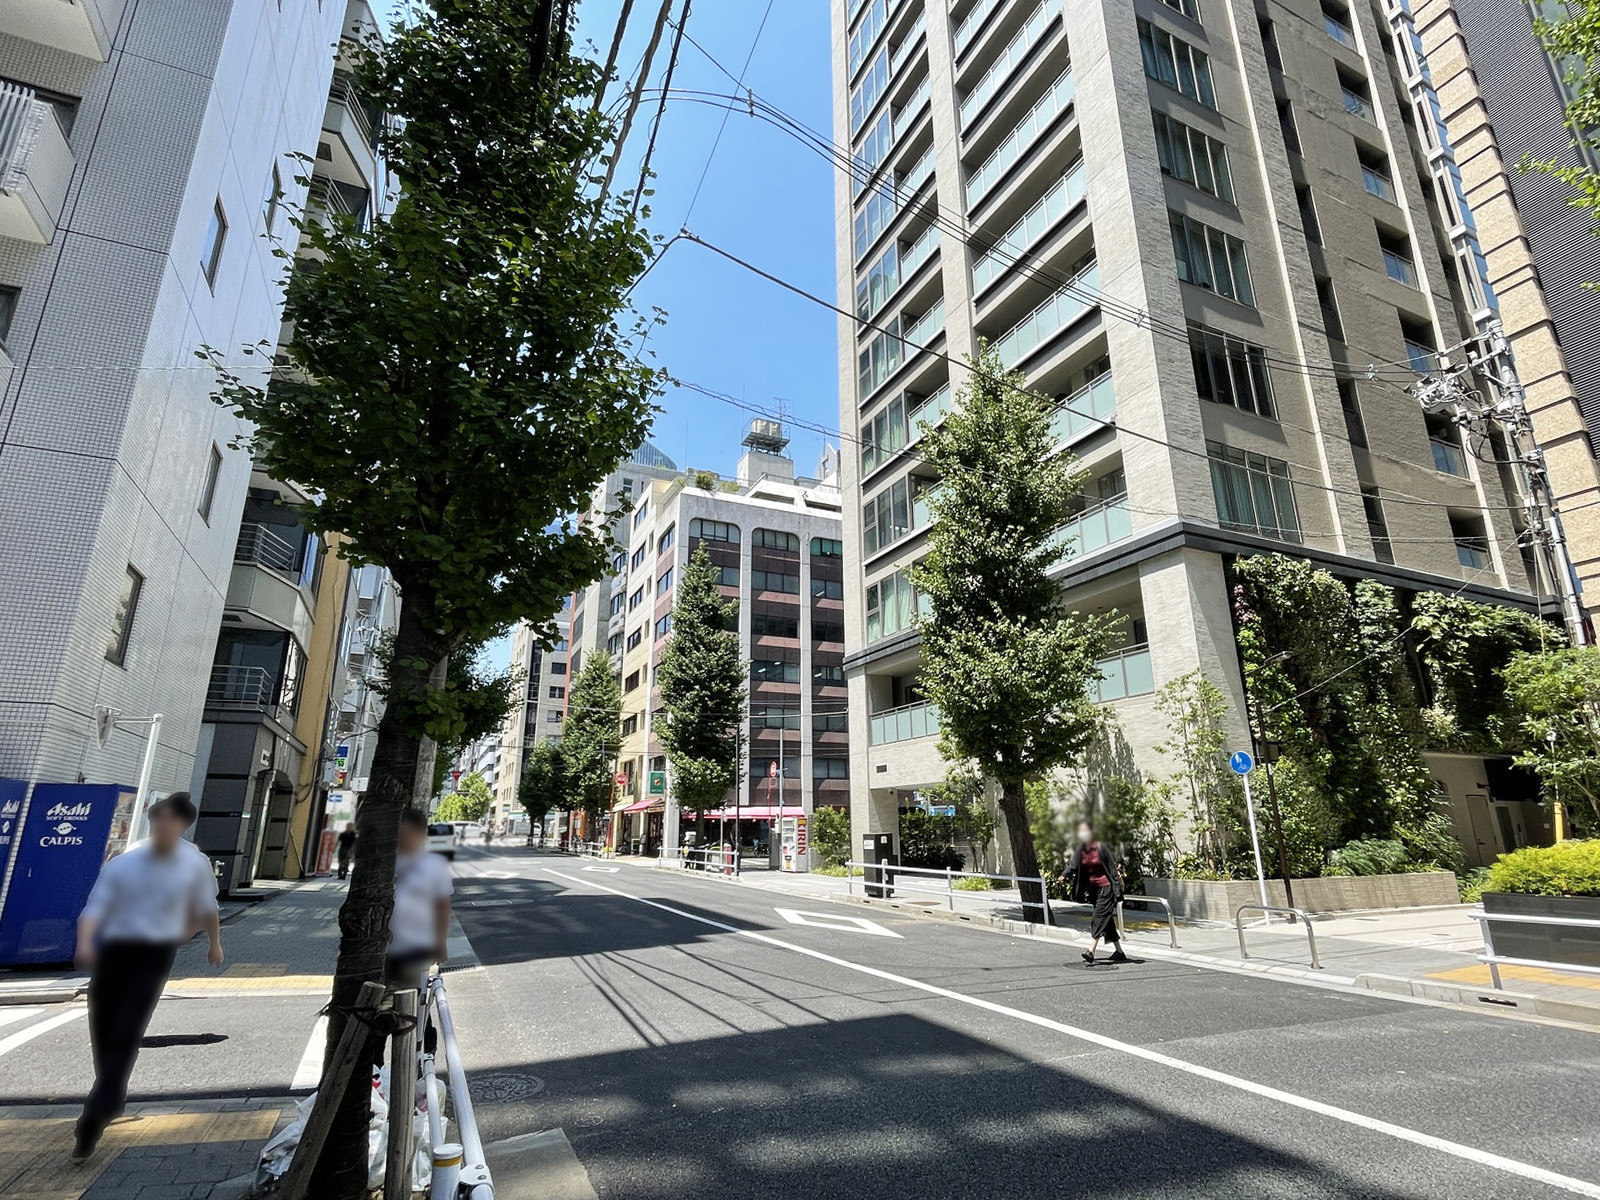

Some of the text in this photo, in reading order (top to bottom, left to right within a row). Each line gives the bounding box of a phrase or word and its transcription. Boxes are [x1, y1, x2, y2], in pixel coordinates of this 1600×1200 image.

[47, 802, 92, 816] Asahi
[40, 836, 83, 847] CALPIS
[797, 821, 806, 855] KIRIN
